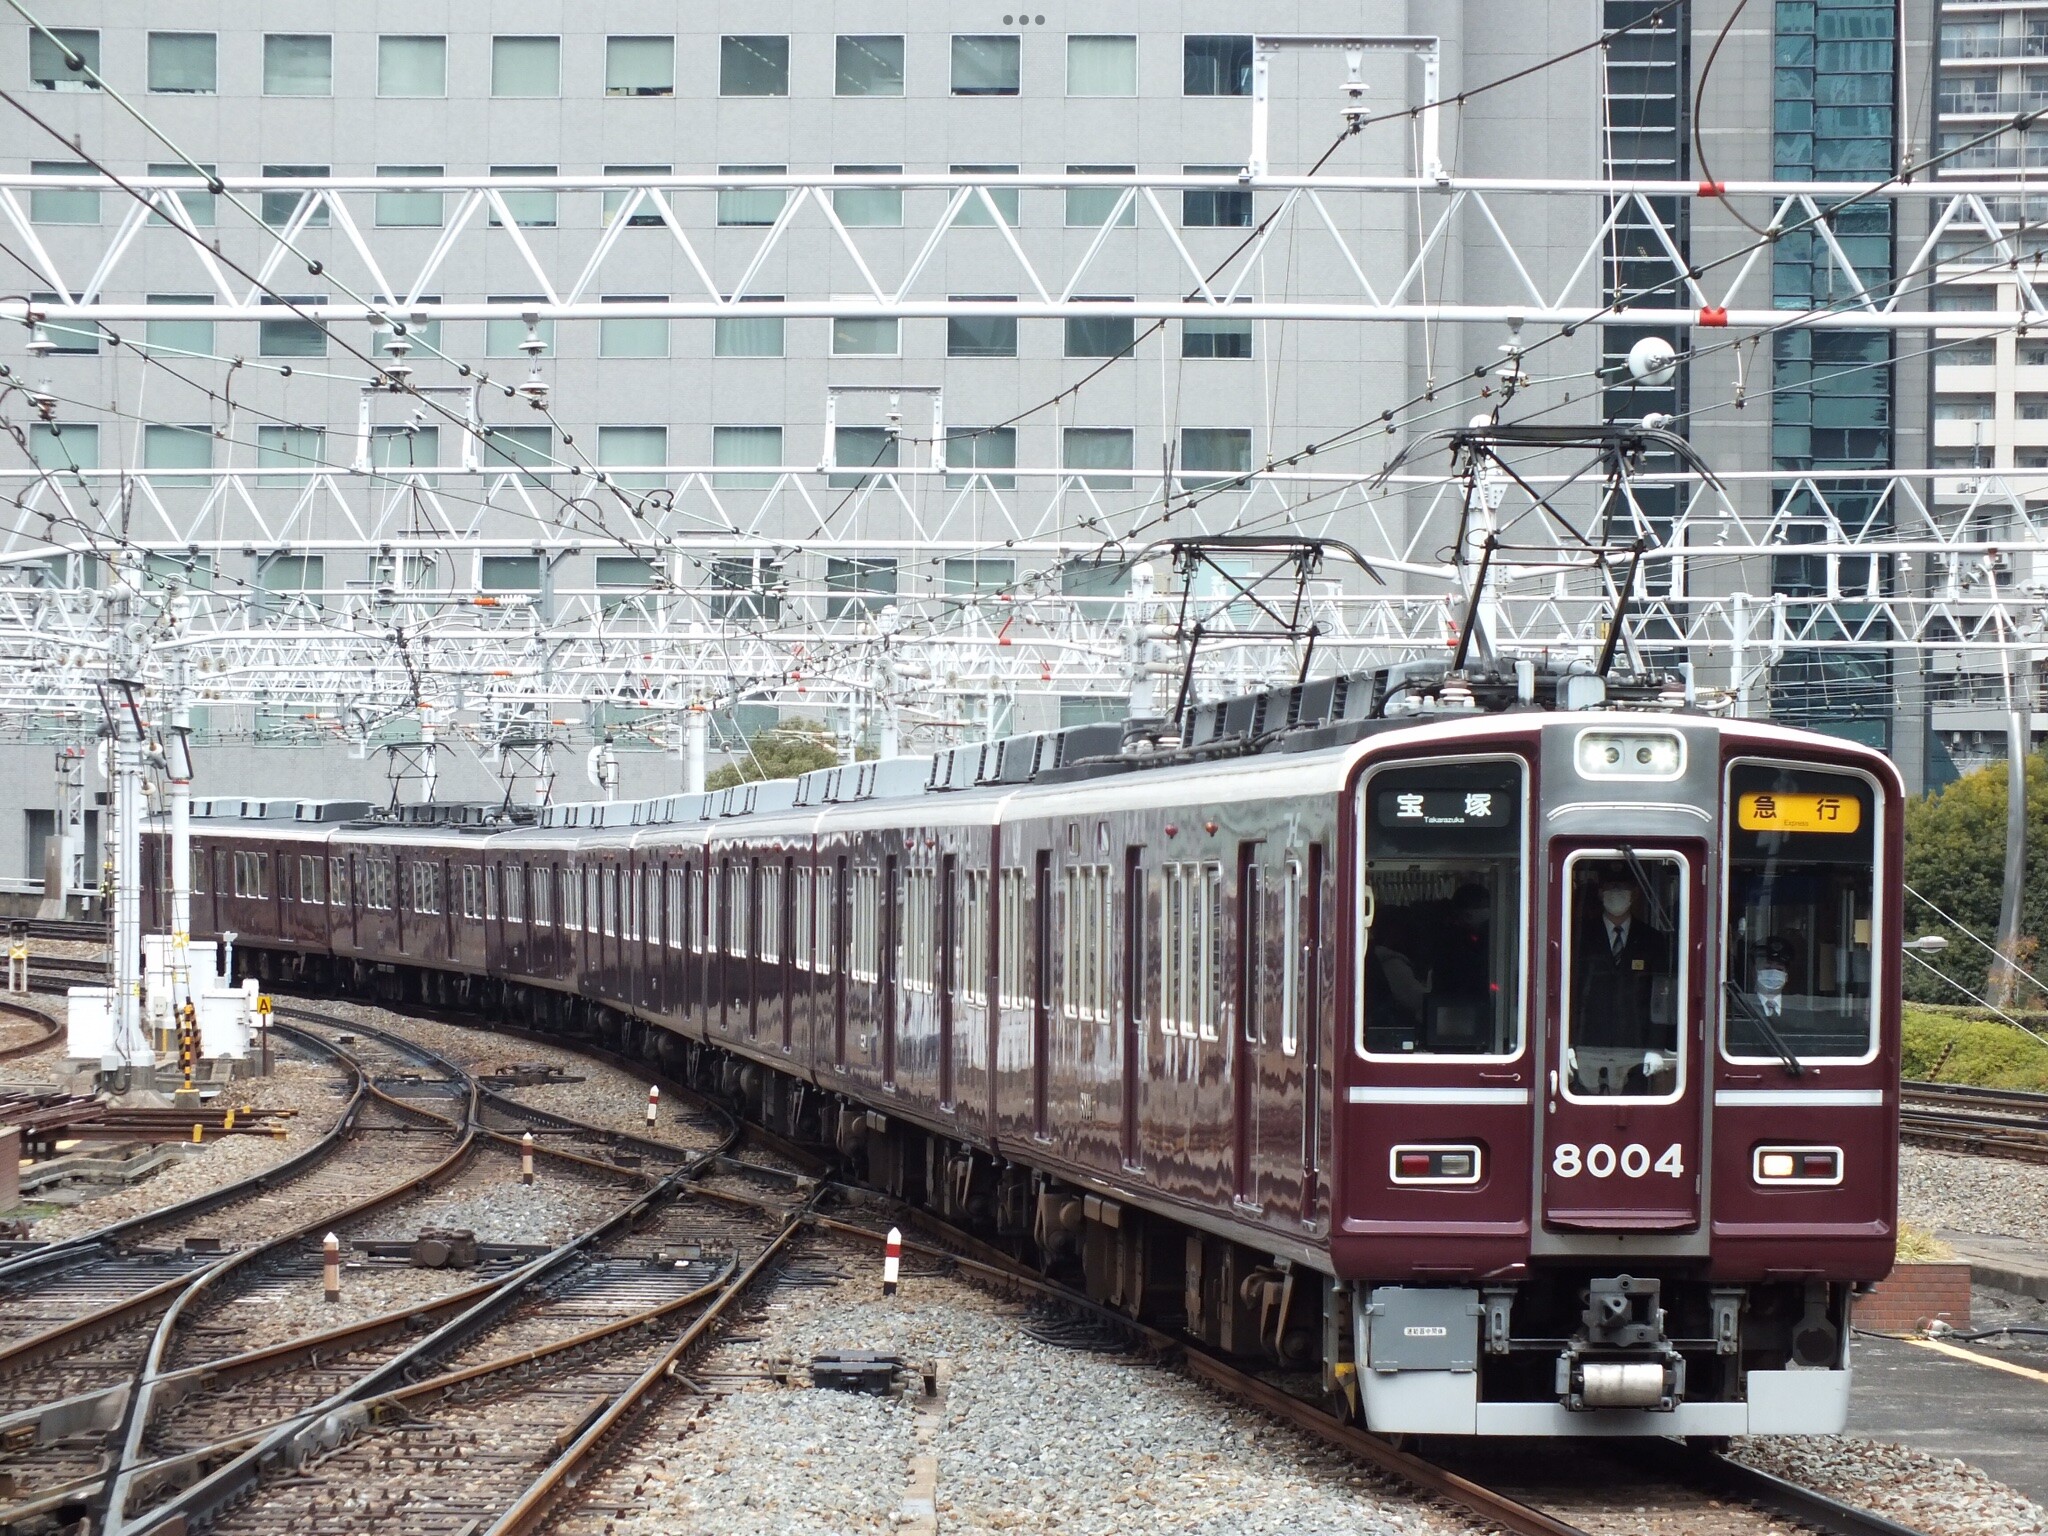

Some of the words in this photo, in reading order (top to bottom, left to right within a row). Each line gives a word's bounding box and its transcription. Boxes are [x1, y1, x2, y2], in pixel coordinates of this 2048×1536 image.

[1396, 793, 1492, 817] 宝塚
[1753, 796, 1840, 820] 急行
[1424, 816, 1465, 824] Takarazuka
[259, 998, 270, 1013] A
[1552, 1143, 1685, 1178] 8004
